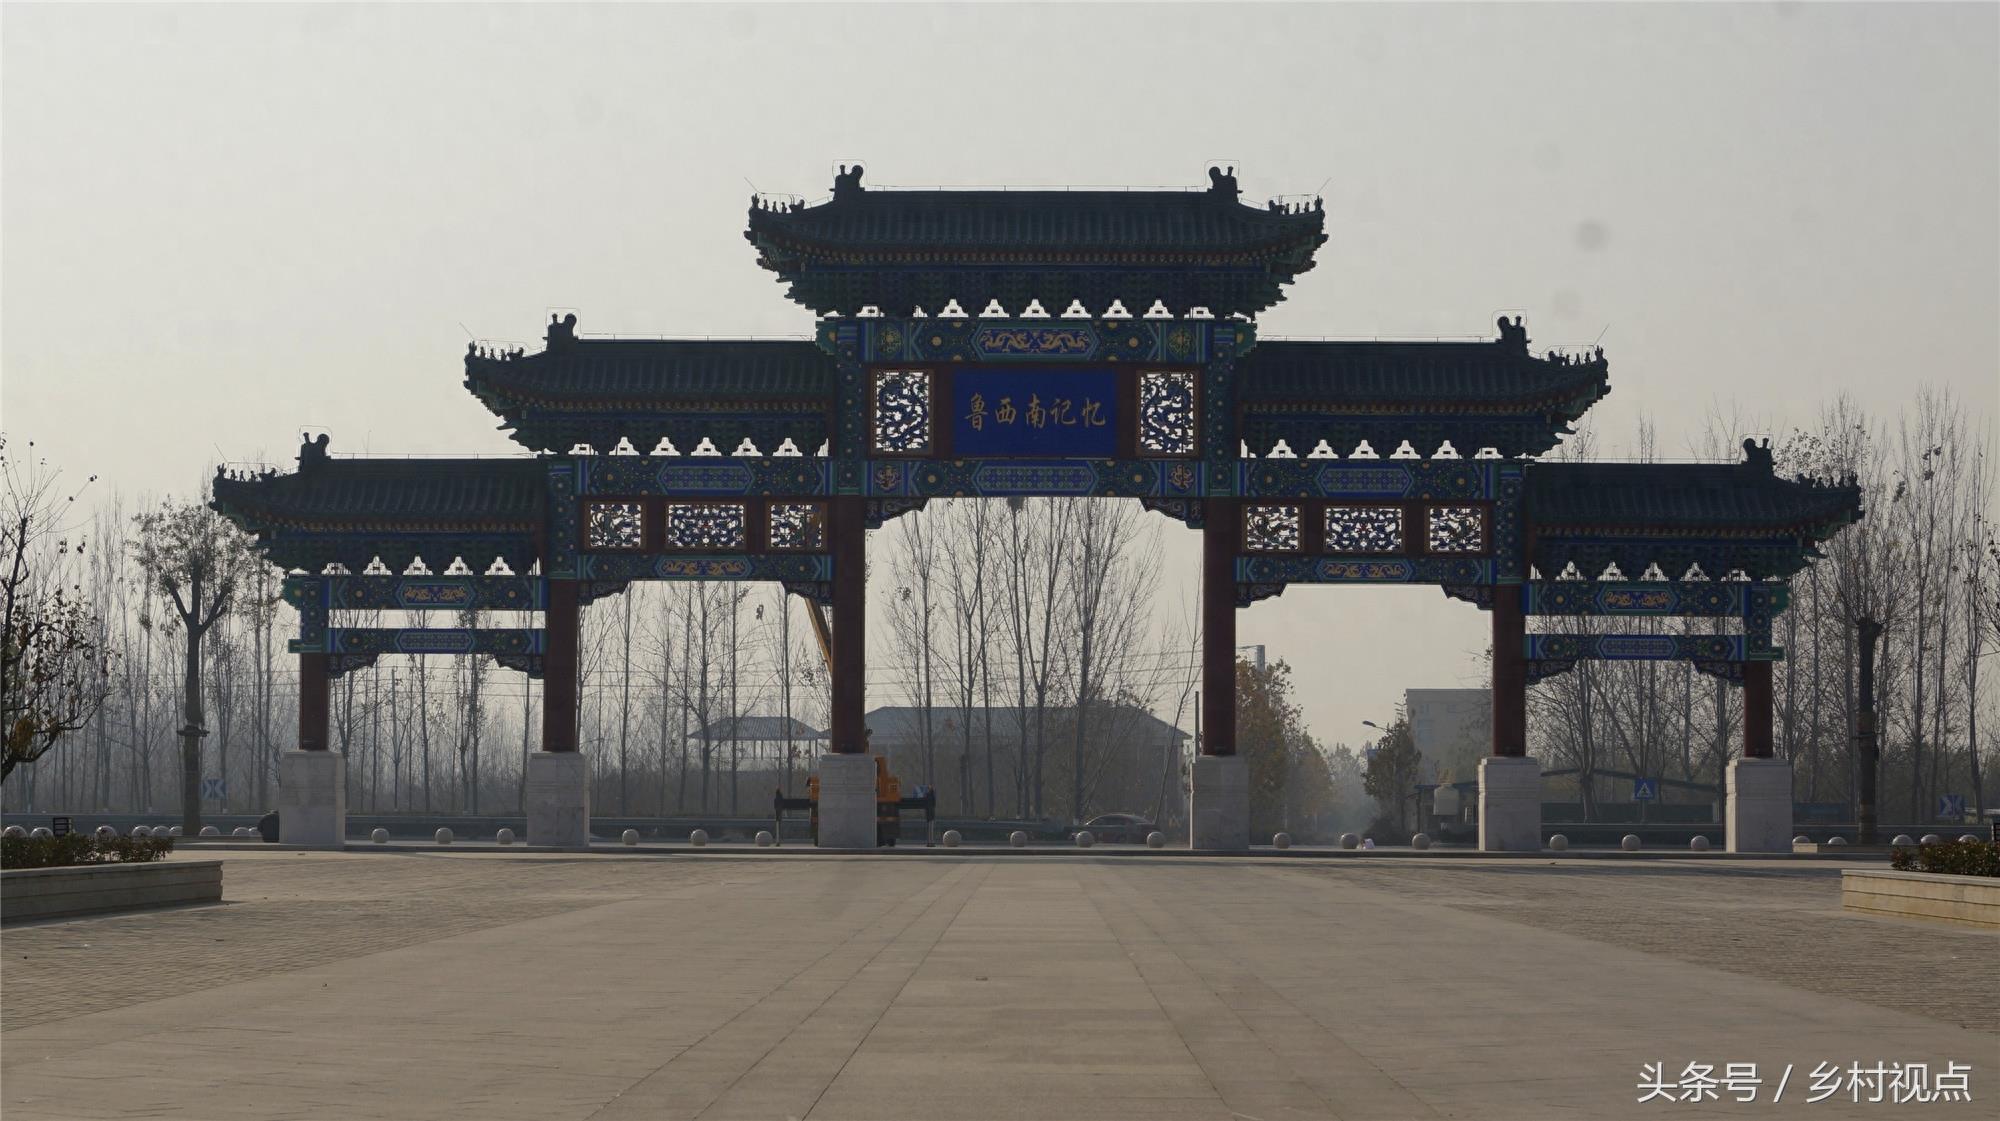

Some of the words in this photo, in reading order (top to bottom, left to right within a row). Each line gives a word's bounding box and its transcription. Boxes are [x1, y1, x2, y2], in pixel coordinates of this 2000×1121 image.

[965, 392, 1106, 431] 鲁西南记忆
